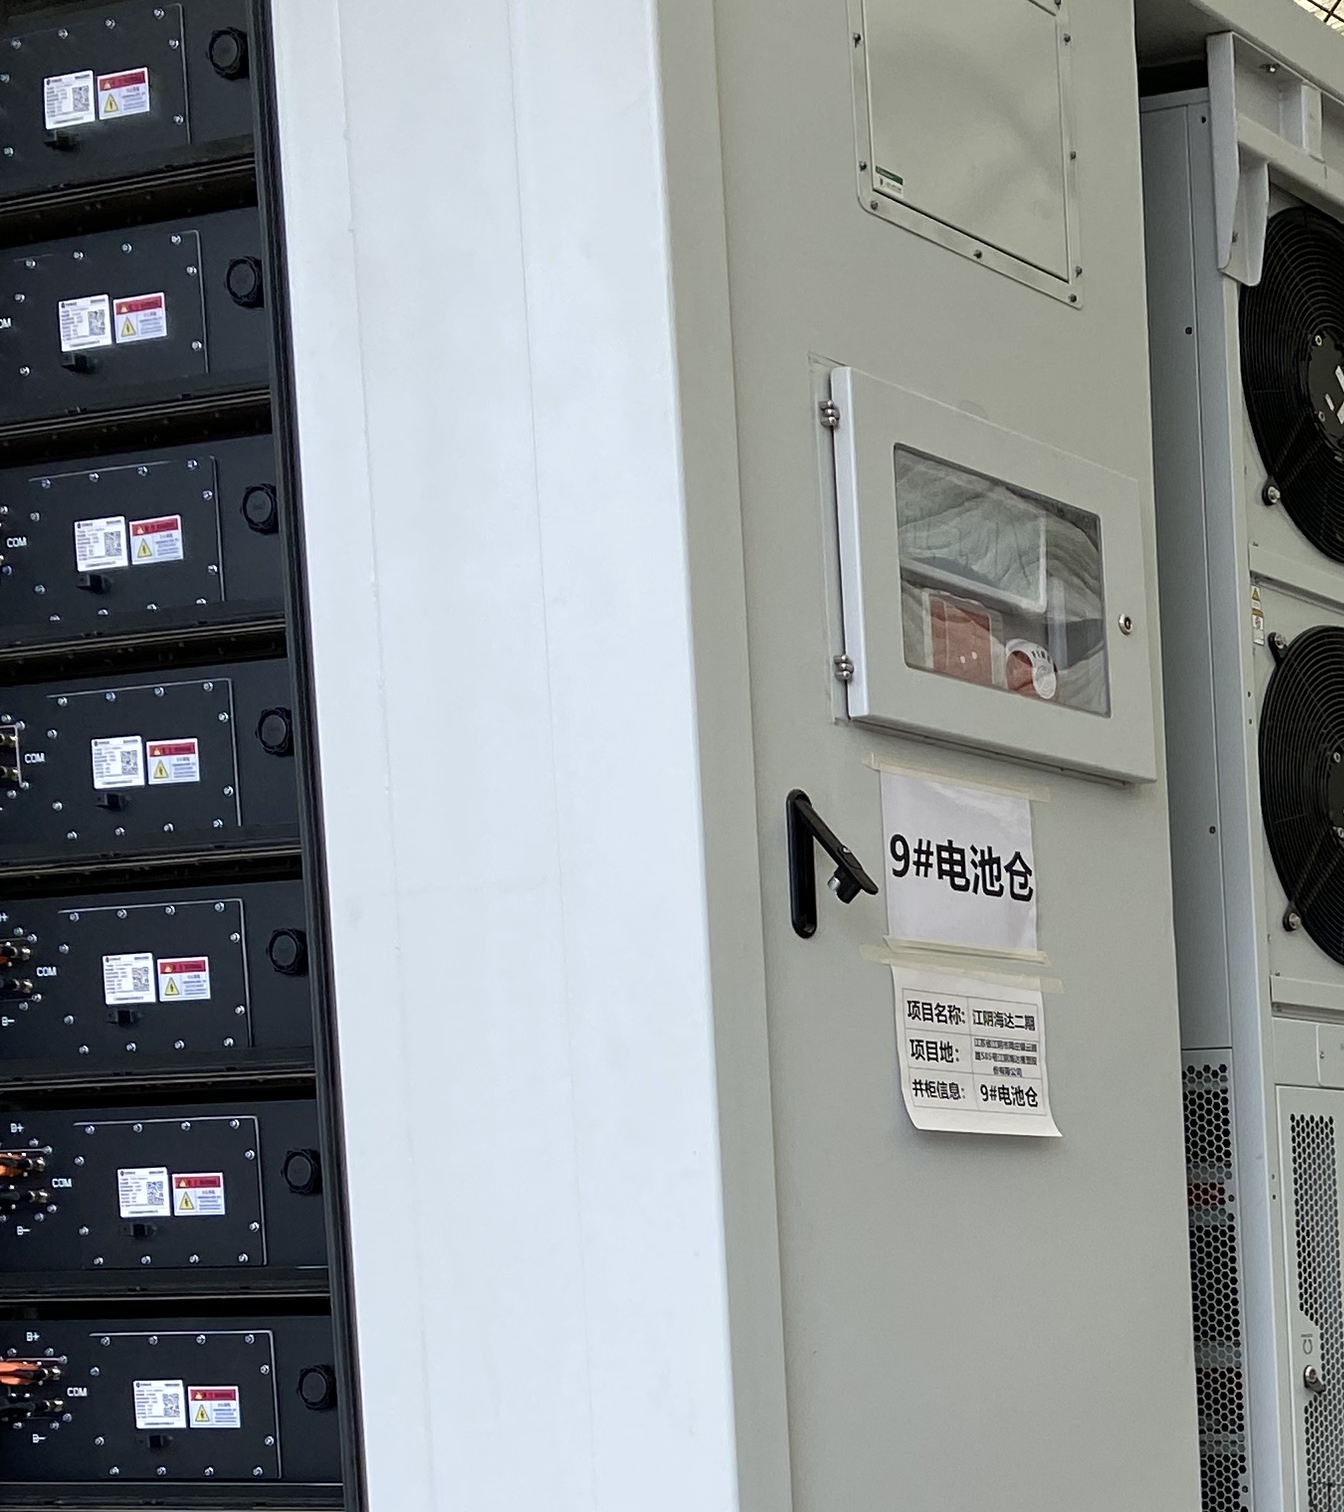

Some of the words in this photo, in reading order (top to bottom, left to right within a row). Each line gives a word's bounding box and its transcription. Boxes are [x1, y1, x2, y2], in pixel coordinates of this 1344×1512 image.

[0, 318, 11, 328] OM
[7, 537, 27, 548] COM
[24, 752, 45, 763] COM
[890, 834, 1034, 902] 9#电池仓
[36, 966, 57, 977] COM
[972, 1009, 1036, 1031] 江阴海达二期
[980, 1084, 1038, 1107] 9#电池仓
[52, 1178, 72, 1188] COM
[67, 1387, 87, 1397] COM
